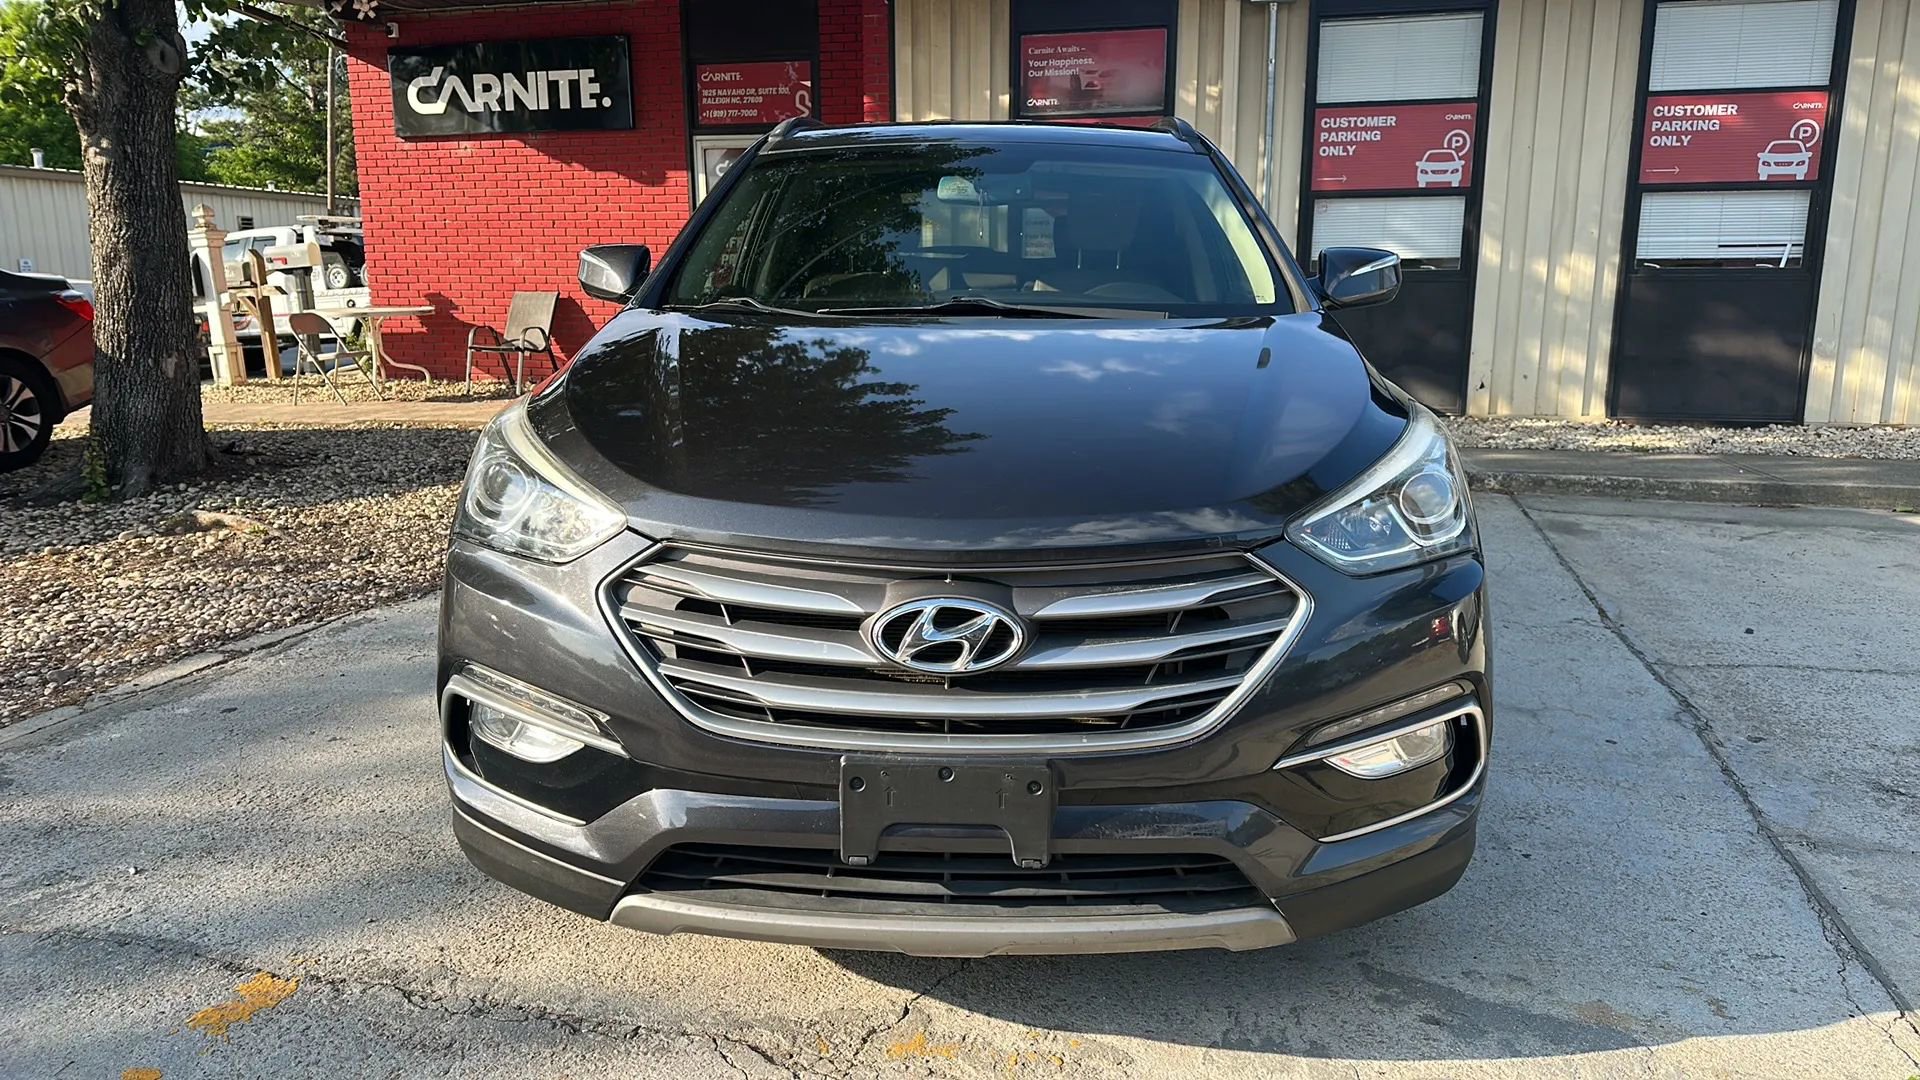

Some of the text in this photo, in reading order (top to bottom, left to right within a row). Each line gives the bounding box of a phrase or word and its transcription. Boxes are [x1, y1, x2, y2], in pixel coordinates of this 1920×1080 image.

[1045, 68, 1079, 76] Mission!
[717, 88, 746, 96] NAVAHO
[758, 87, 777, 95] SUITE
[702, 97, 731, 105] RALEIGH
[1653, 104, 1738, 117] CUSTOMER
[1321, 116, 1397, 129] CUSTOMER
[1651, 119, 1720, 132] PARKING
[1320, 131, 1381, 142] PARKING
[1650, 135, 1692, 147] ONLY
[1319, 145, 1356, 157] ONLY
